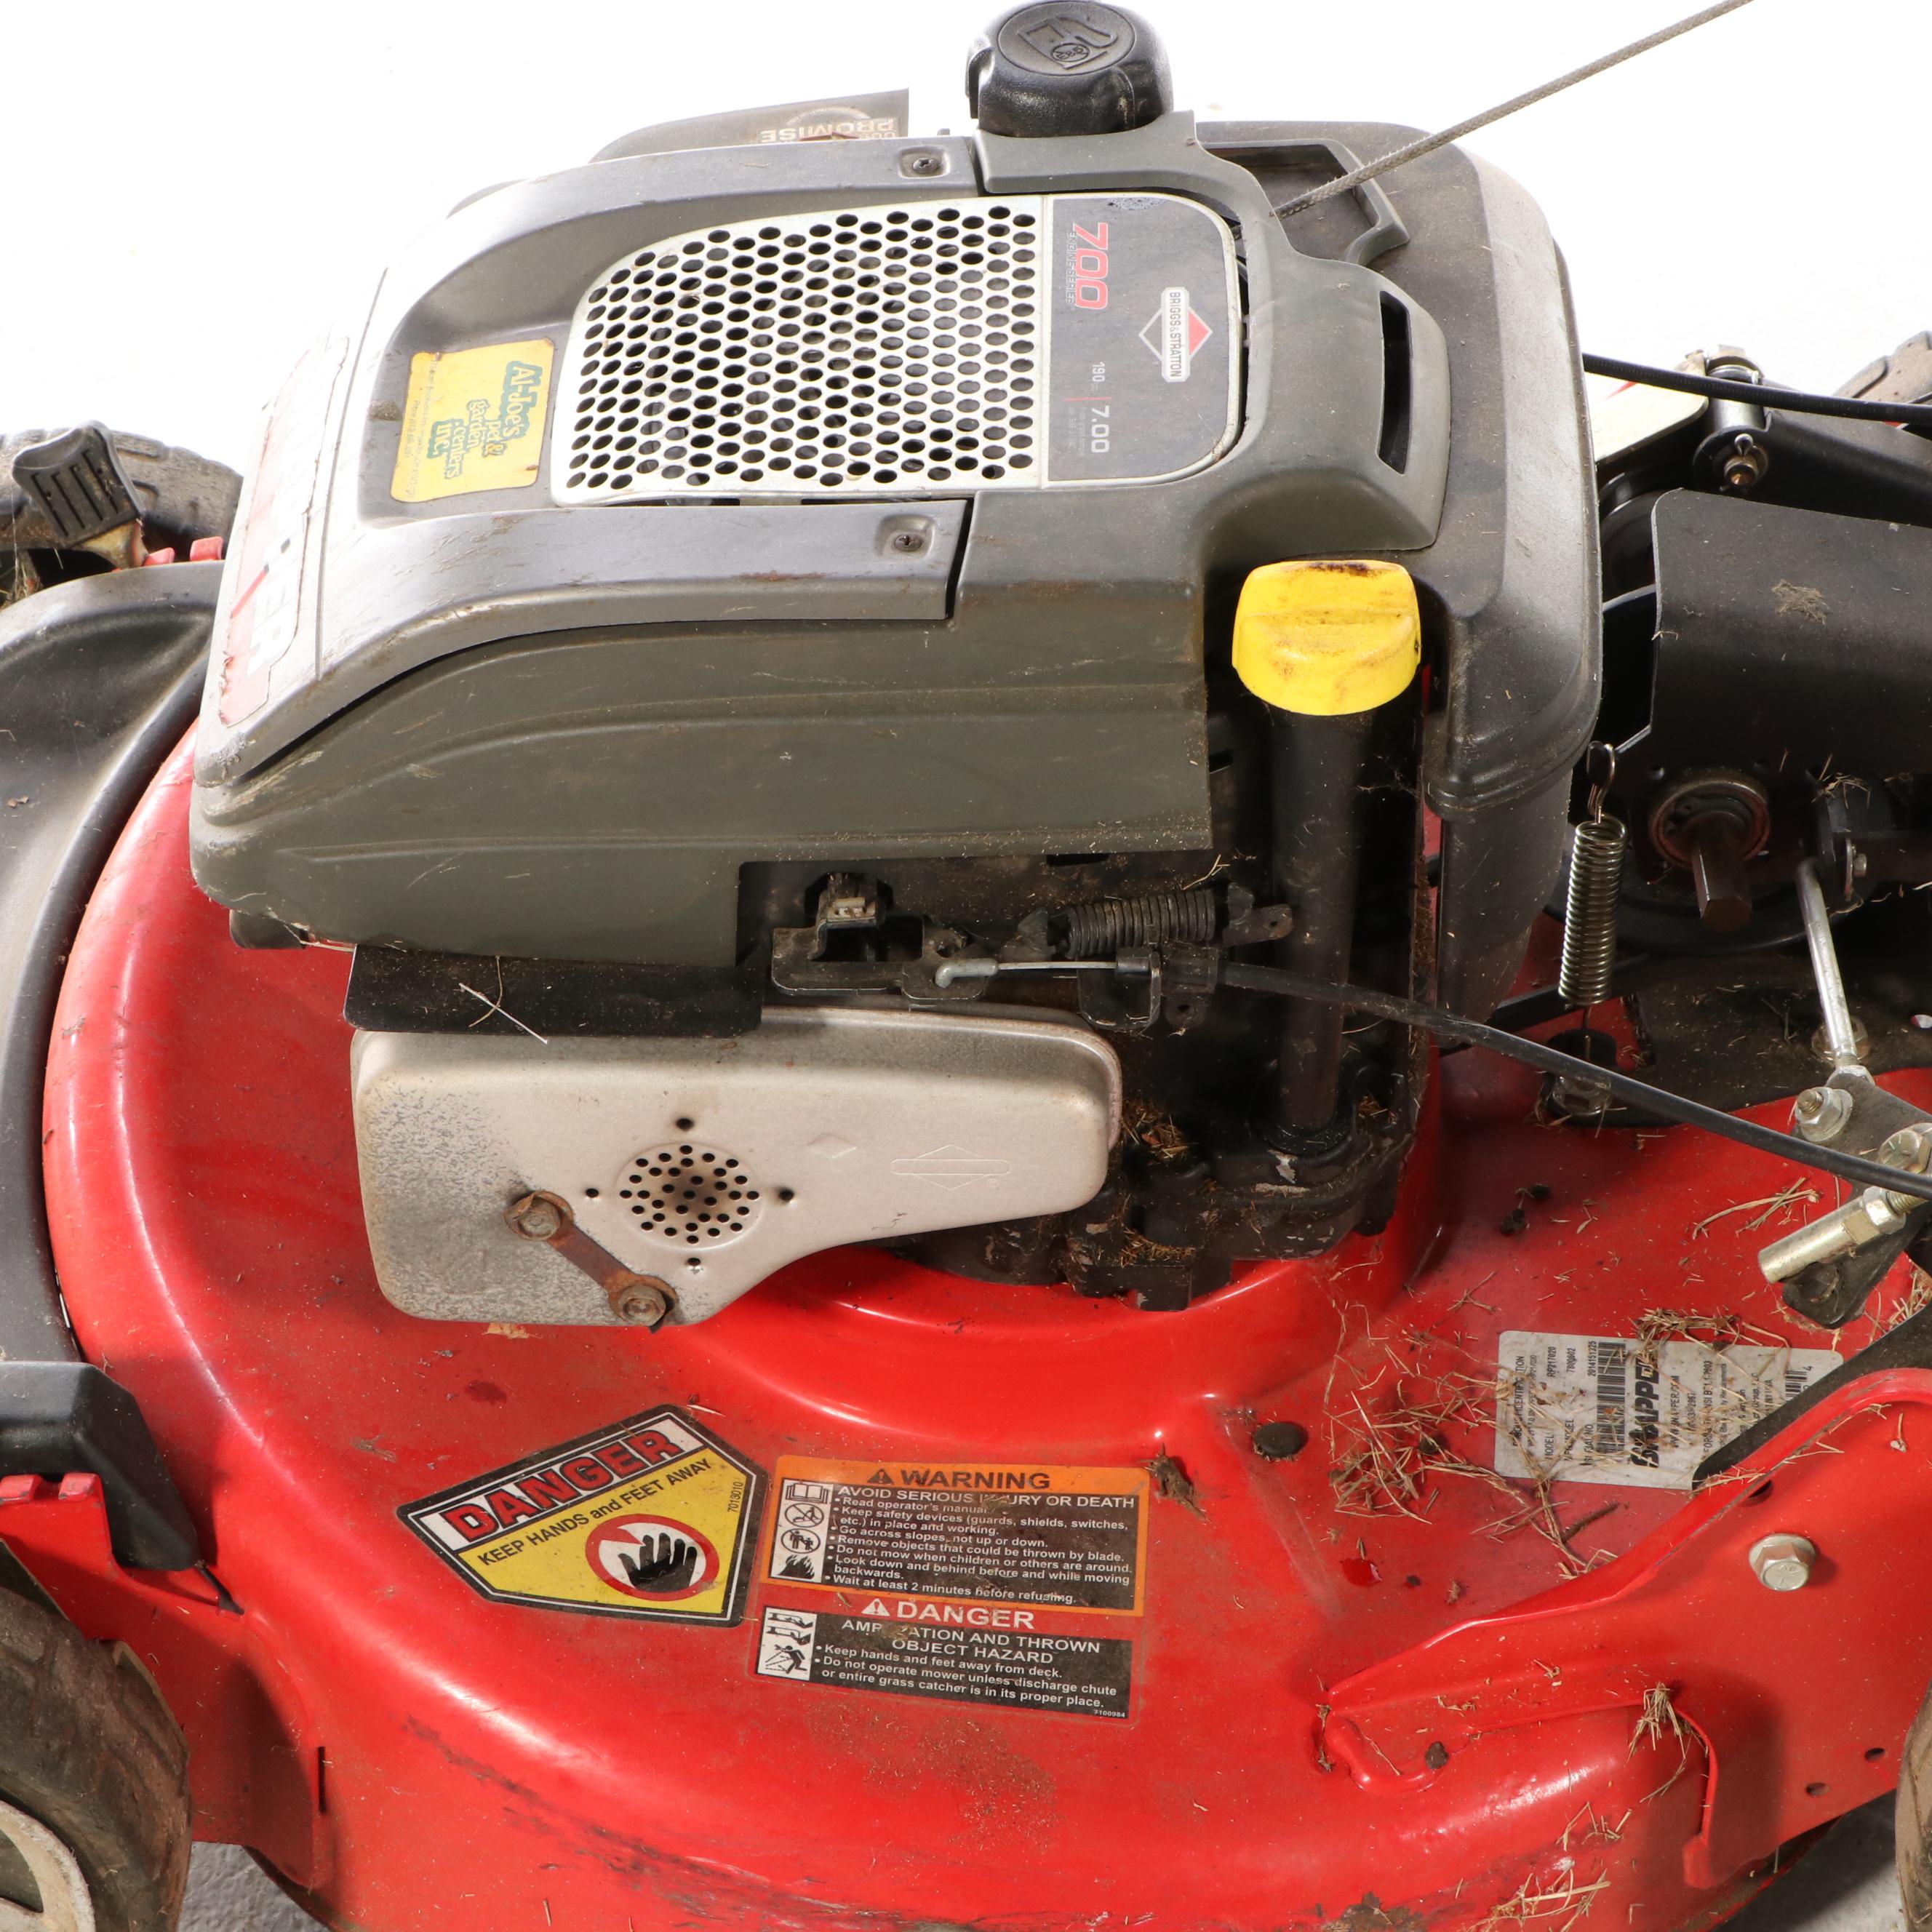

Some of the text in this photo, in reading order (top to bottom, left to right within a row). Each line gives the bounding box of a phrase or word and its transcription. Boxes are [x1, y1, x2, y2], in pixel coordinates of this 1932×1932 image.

[1072, 222, 1109, 310] 700
[1092, 362, 1106, 382] 190
[503, 366, 536, 438] Al-Joe's
[468, 401, 487, 449] garden
[485, 420, 502, 441] pet
[1090, 404, 1110, 453] 7.00
[1631, 1353, 1659, 1468] SNAPPE
[439, 1429, 687, 1542] DANGER
[901, 1469, 1050, 1489] WARNING
[477, 1457, 713, 1566] KEEP HANDS and FEET AWAY
[727, 1481, 745, 1514] 7013010
[838, 1486, 1135, 1508] AVOID SERIOUS IURY OR DEATH
[842, 1496, 874, 1507] Read
[877, 1500, 938, 1512] operator's
[840, 1517, 999, 1536] etc.) in place and working.
[842, 1506, 1128, 1530] Keep safety devices (guards, shields, switches,
[838, 1535, 1125, 1562] Remove objects that could be thrown by blade.
[839, 1525, 857, 1535] Go
[860, 1530, 901, 1538] across
[953, 1534, 973, 1544] not
[976, 1538, 991, 1547] up
[1011, 1538, 1048, 1547] down.
[834, 1565, 904, 1579] backwards.
[836, 1554, 1130, 1586] Look down and behind before and while moving
[837, 1544, 854, 1554] Do
[857, 1546, 877, 1556] not
[880, 1550, 911, 1559] mow
[914, 1552, 946, 1562] when
[950, 1554, 999, 1565] children
[1020, 1559, 1059, 1569] others
[1063, 1562, 1082, 1570] are
[1085, 1563, 1132, 1573] around.
[833, 1575, 860, 1586] Wait
[863, 1578, 875, 1587] at
[878, 1579, 909, 1590] least
[911, 1583, 919, 1591] 2
[922, 1584, 972, 1595] minutes
[975, 1589, 1015, 1599] before
[897, 1601, 1035, 1629] DANGER
[841, 1619, 1101, 1653] AMPATION AND THROWN
[825, 1644, 1063, 1678] Keep hands and feet away from deck.
[892, 1639, 1053, 1664] OBJECT HAZARD
[821, 1669, 1104, 1708] or entire grass catcher is in its proper place.
[823, 1656, 1117, 1696] Do not operate mower unless discharge chute
